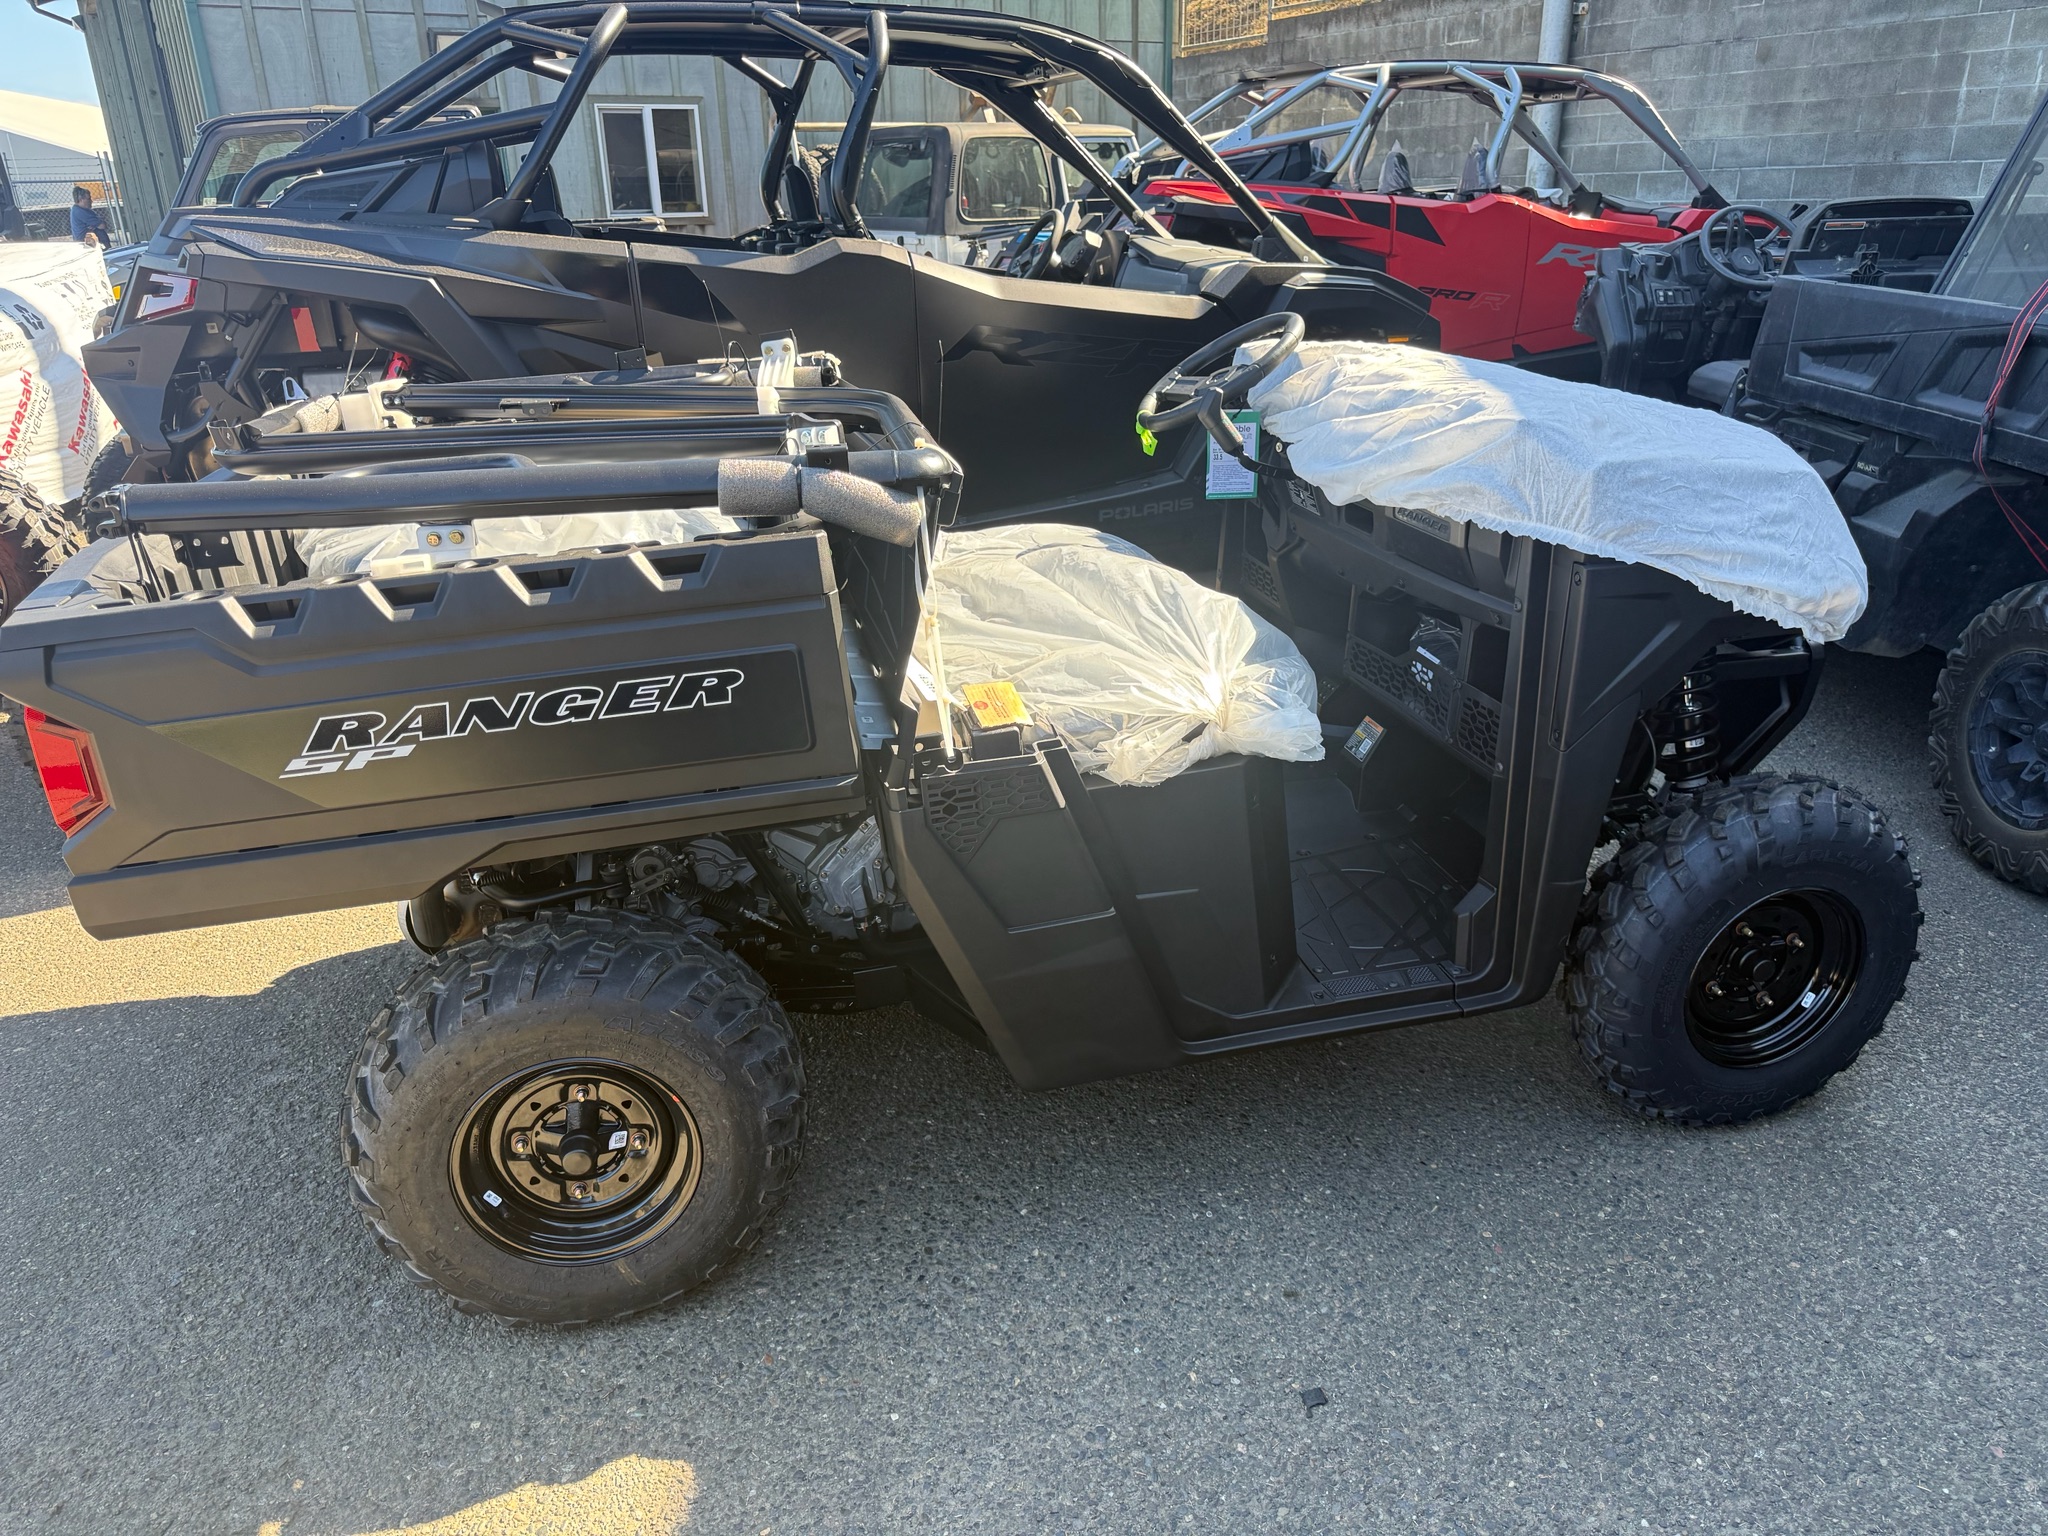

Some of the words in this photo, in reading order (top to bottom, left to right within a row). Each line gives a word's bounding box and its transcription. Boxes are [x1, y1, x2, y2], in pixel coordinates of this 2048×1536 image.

[30, 384, 51, 436] VEHICLE
[67, 366, 91, 455] Kawasa
[1098, 497, 1194, 522] POLARIS
[302, 668, 744, 756] RANGER
[279, 744, 416, 779] SP
